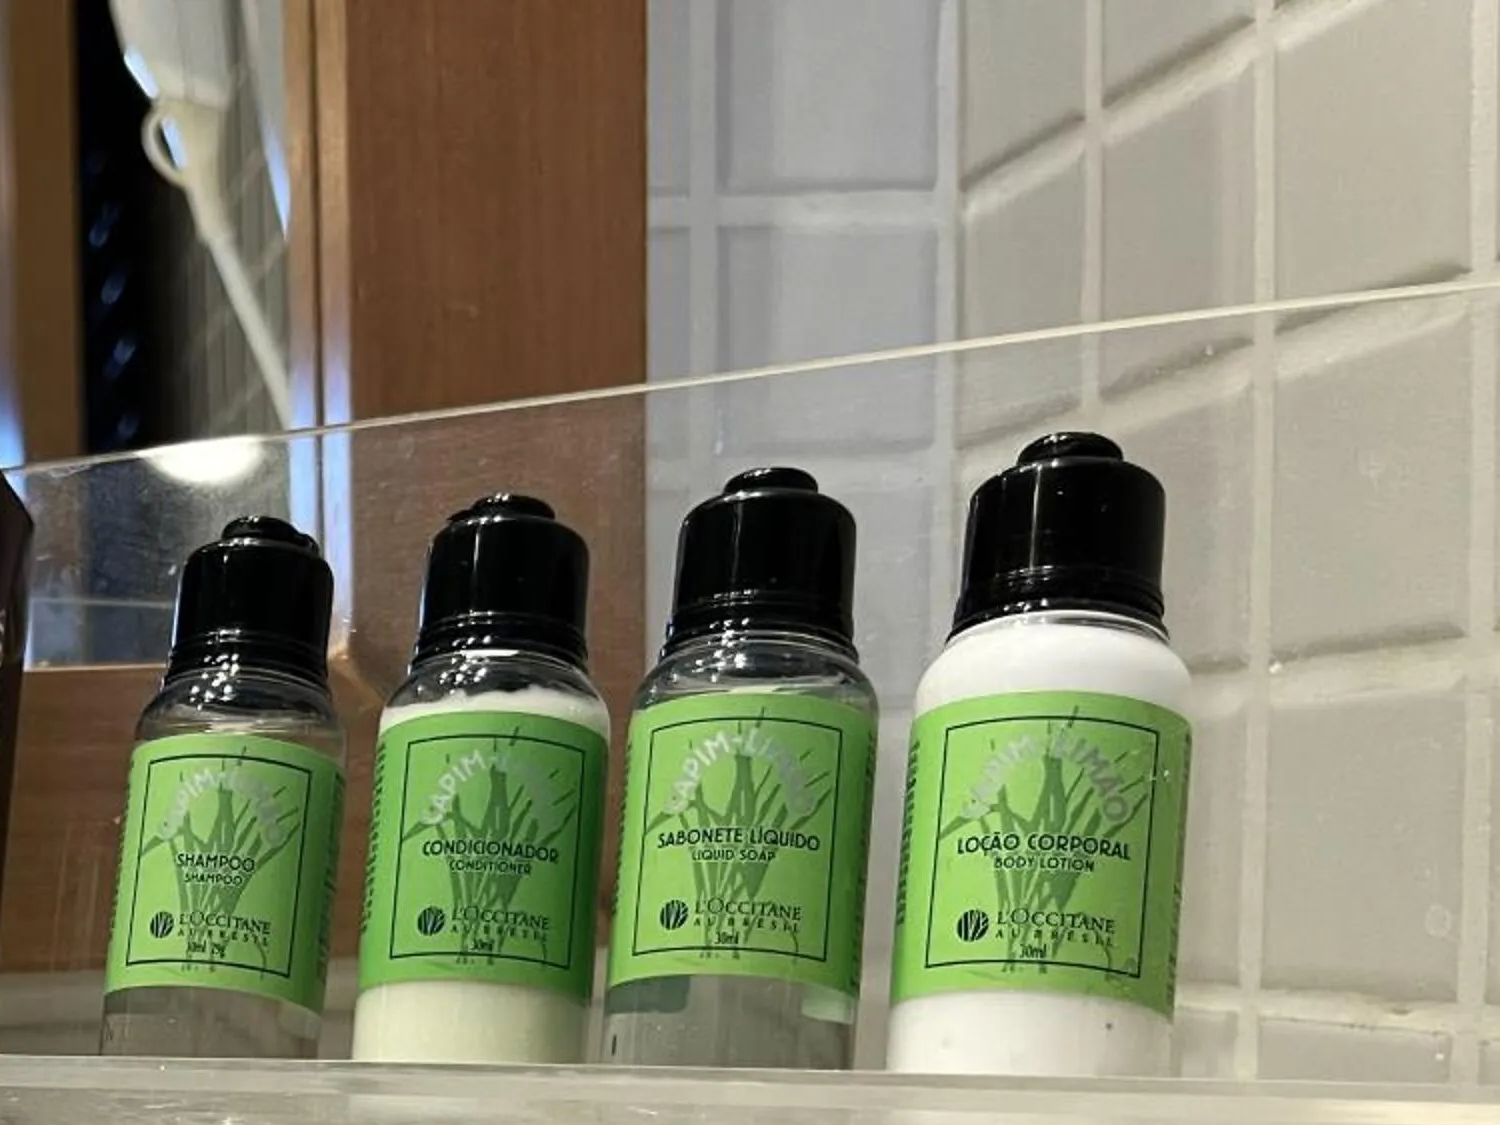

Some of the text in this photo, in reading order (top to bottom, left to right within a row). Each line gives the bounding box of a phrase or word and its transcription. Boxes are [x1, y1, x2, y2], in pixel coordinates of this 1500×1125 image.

[657, 826, 821, 851] SABONETE LÍQUIDO
[957, 832, 1131, 860] LOÇÃO CORPORAL
[177, 852, 256, 872] SHAMPOO
[422, 839, 559, 864] CONDICIONADOR
[691, 848, 776, 863] LIQUID SOAP
[449, 859, 532, 875] CONDITIONER
[994, 857, 1095, 873] BODY LOTION
[184, 872, 243, 886] SHAMPOO
[451, 905, 550, 930] L'OCCITANE
[694, 897, 802, 921] L'OCCITANE
[996, 907, 1116, 934] L'OCCITANE
